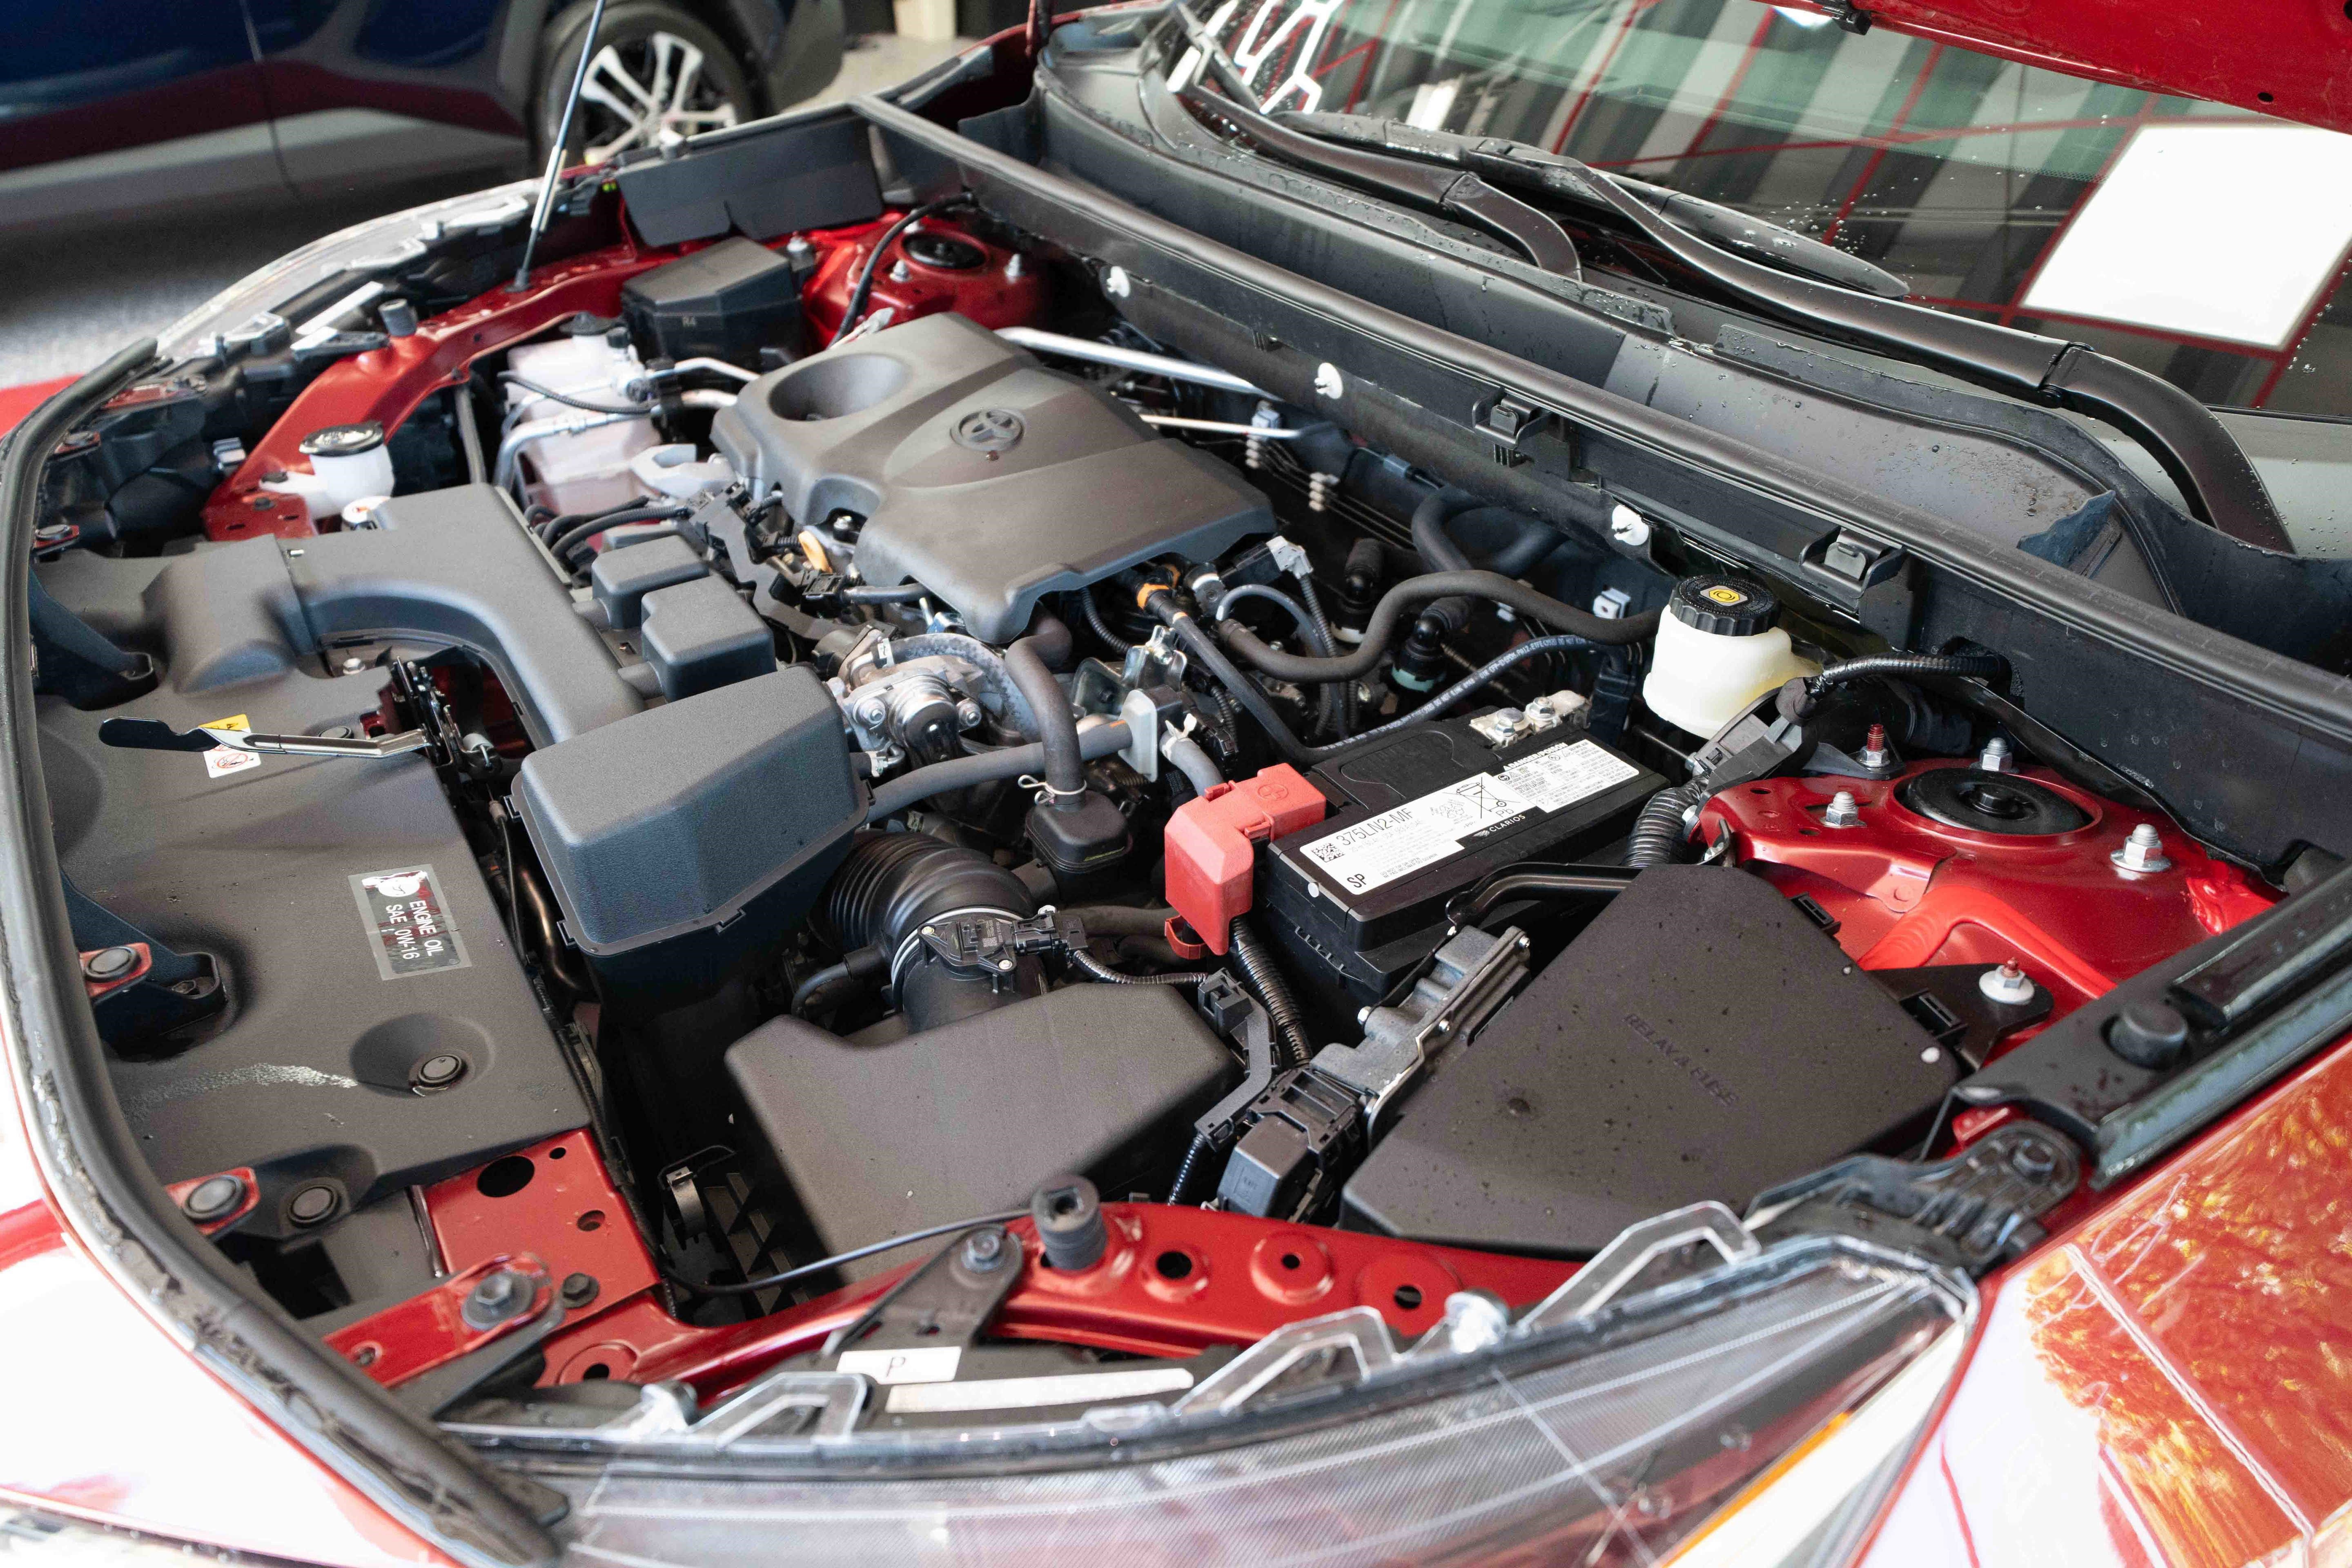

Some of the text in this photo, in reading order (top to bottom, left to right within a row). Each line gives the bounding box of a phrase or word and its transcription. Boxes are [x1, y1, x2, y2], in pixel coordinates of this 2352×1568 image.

[1489, 814, 1526, 832] CLARIOS
[1495, 808, 1515, 818] Pb
[1335, 807, 1413, 846] 375LN2-MF
[1347, 873, 1367, 888] SP
[386, 904, 408, 924] SAE
[409, 900, 444, 957] ENGINE OIL
[886, 1356, 906, 1378] P
